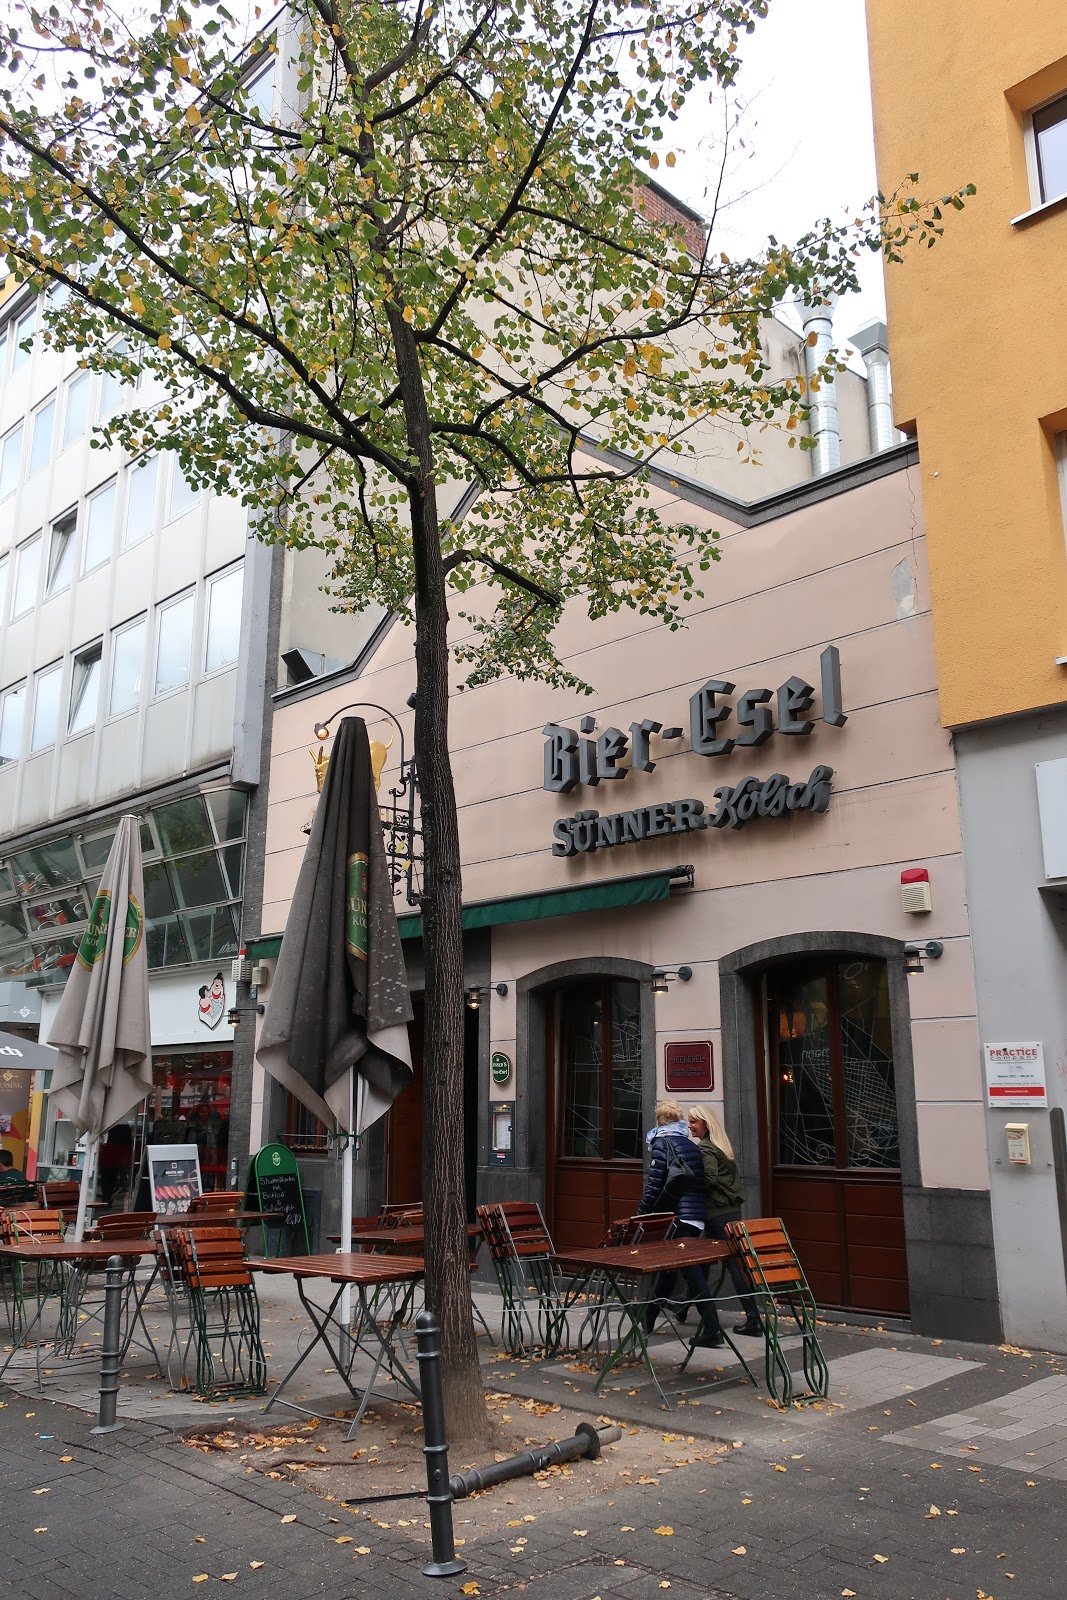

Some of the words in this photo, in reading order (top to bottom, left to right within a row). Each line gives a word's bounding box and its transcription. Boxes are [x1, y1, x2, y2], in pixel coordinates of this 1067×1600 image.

[543, 645, 848, 793] Bier-Esel
[551, 799, 707, 857] SÜNNER
[706, 765, 834, 831] Kölsch
